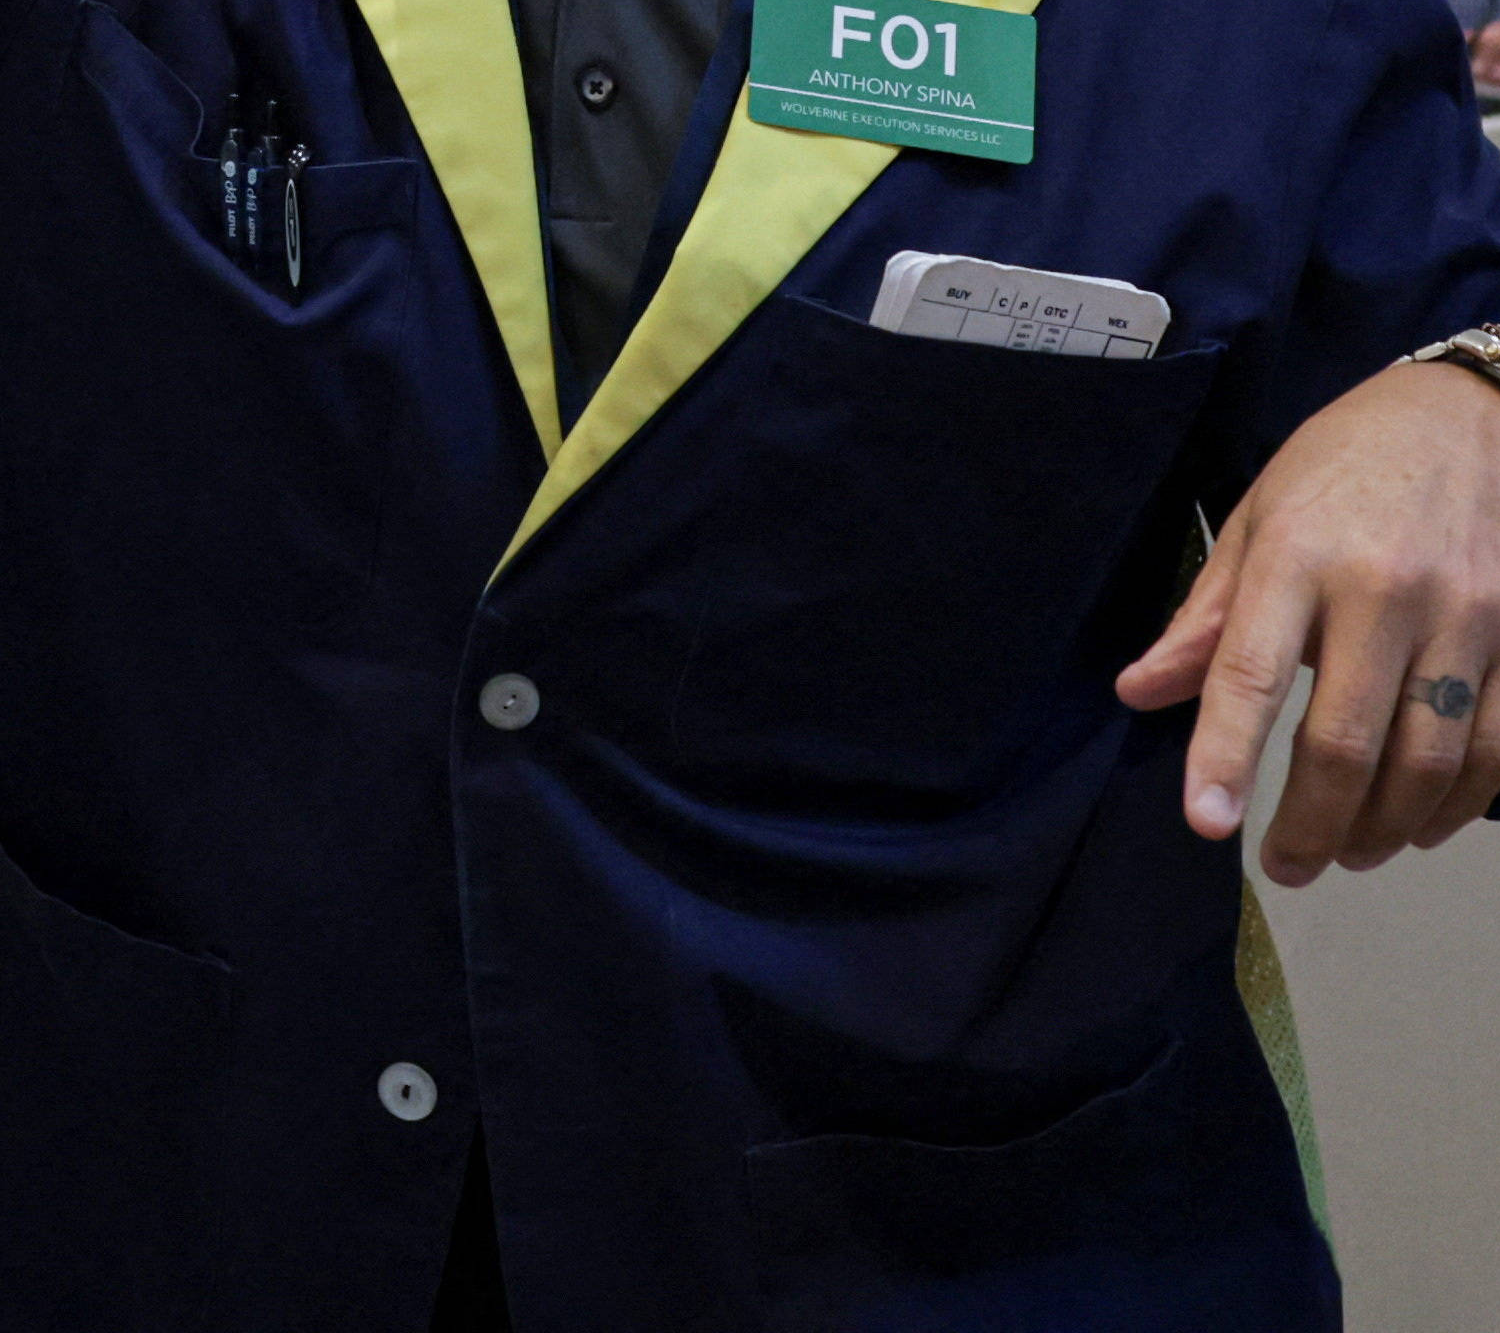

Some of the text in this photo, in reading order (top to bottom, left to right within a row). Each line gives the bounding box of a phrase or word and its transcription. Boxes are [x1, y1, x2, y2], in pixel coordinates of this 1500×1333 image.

[808, 69, 977, 110] ANTHONY SPINA
[780, 101, 1001, 146] WOLVERINE EXECUTION SERVICES LLC
[946, 287, 1129, 330] BUY C P GTC WEX
